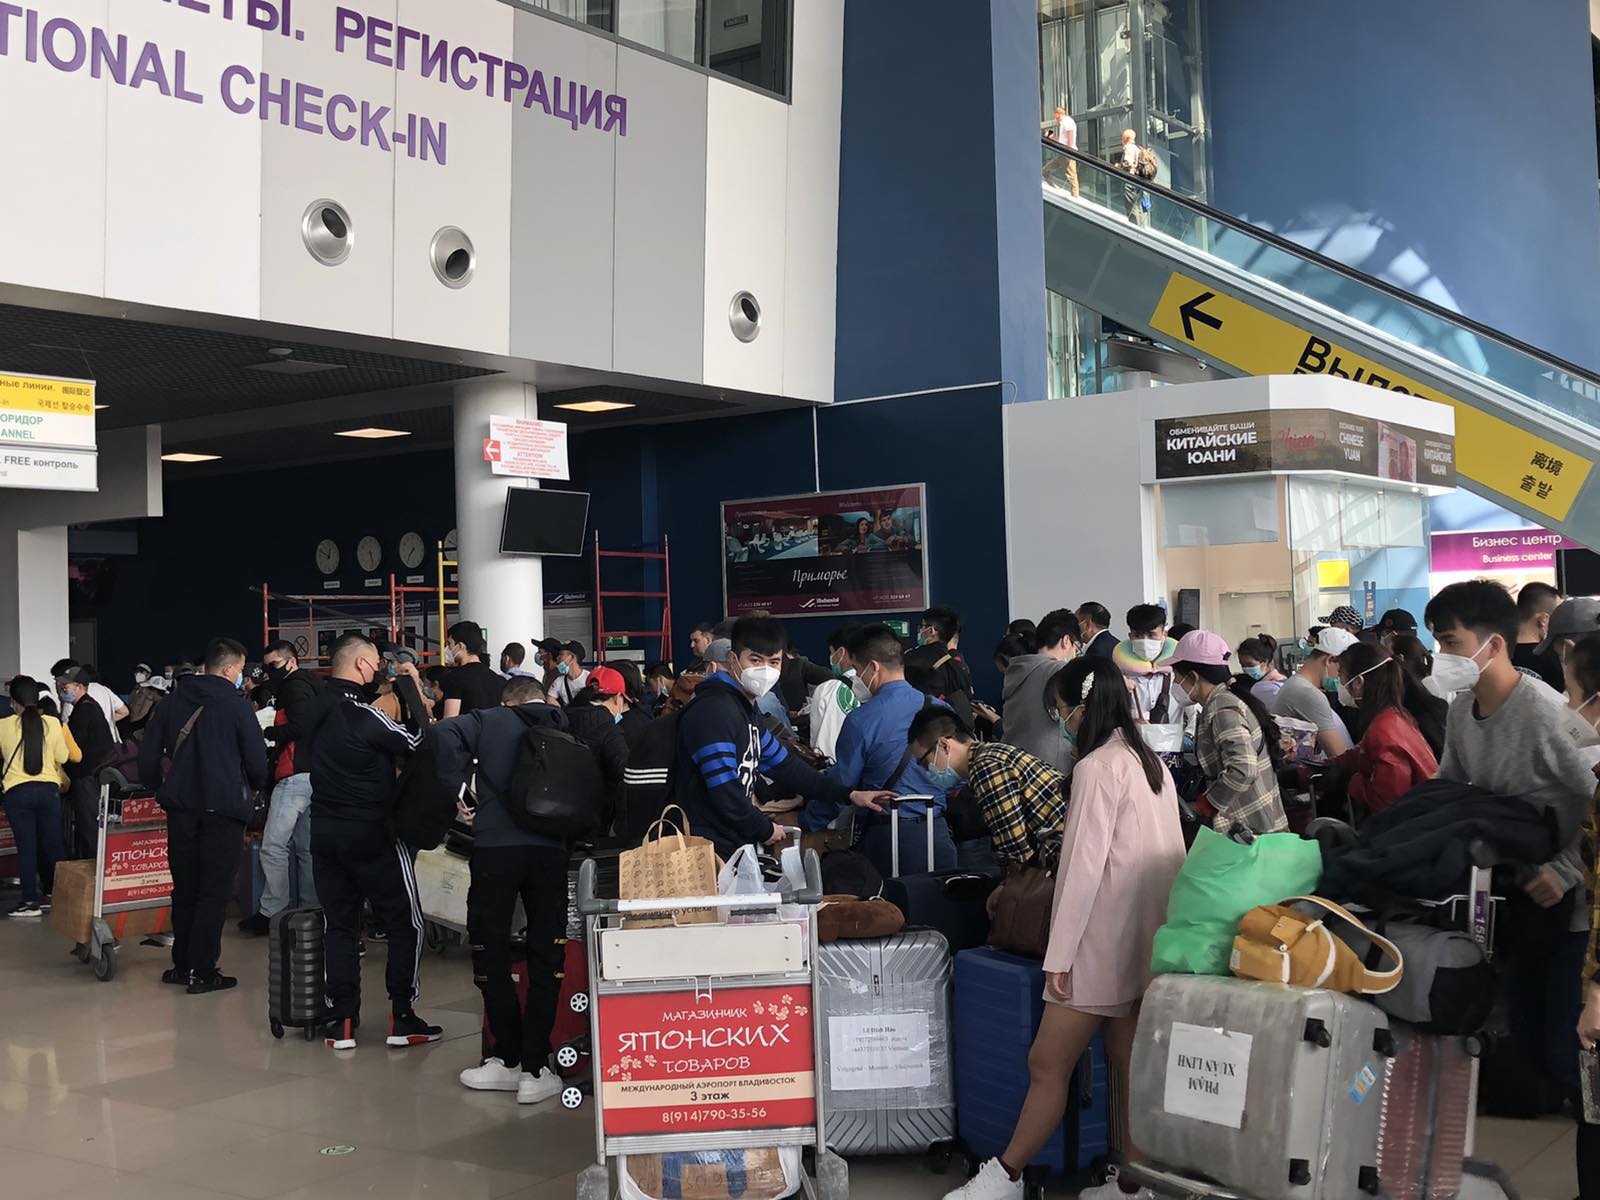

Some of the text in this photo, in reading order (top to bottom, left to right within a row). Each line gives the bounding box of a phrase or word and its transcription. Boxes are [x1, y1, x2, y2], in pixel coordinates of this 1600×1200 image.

[335, 6, 627, 137] РЕГИСТРАЦИЯ
[0, 1, 446, 165] TIONAL CHECK-IN
[1169, 422, 1255, 436] ОБМЕНИВАЙТЕ ВАШИ
[1166, 431, 1258, 451] КИТАЙСКИЕ
[1339, 431, 1364, 447] CHINESE
[4, 455, 79, 470] FREE контроль
[1187, 448, 1236, 464] ЮАНИ
[1472, 534, 1563, 548] Бизнес центр
[1482, 552, 1553, 564] Business center
[792, 569, 848, 589] Приморье
[112, 847, 168, 863] ЯПОНСК
[662, 1008, 748, 1022] МАГАЗИНЧИК
[618, 1023, 791, 1053] ЯПОНСКИХ
[662, 1055, 751, 1073] ТОВАРОВ
[1177, 1054, 1203, 1071] LINH
[621, 1076, 797, 1093] МЕЖДУНАРОДНЫЙ АЭРОПОРТ ВЛАДИВОСТОК
[690, 1091, 730, 1101] 3 этаж
[662, 1107, 767, 1125] 8(914)790-35-56
